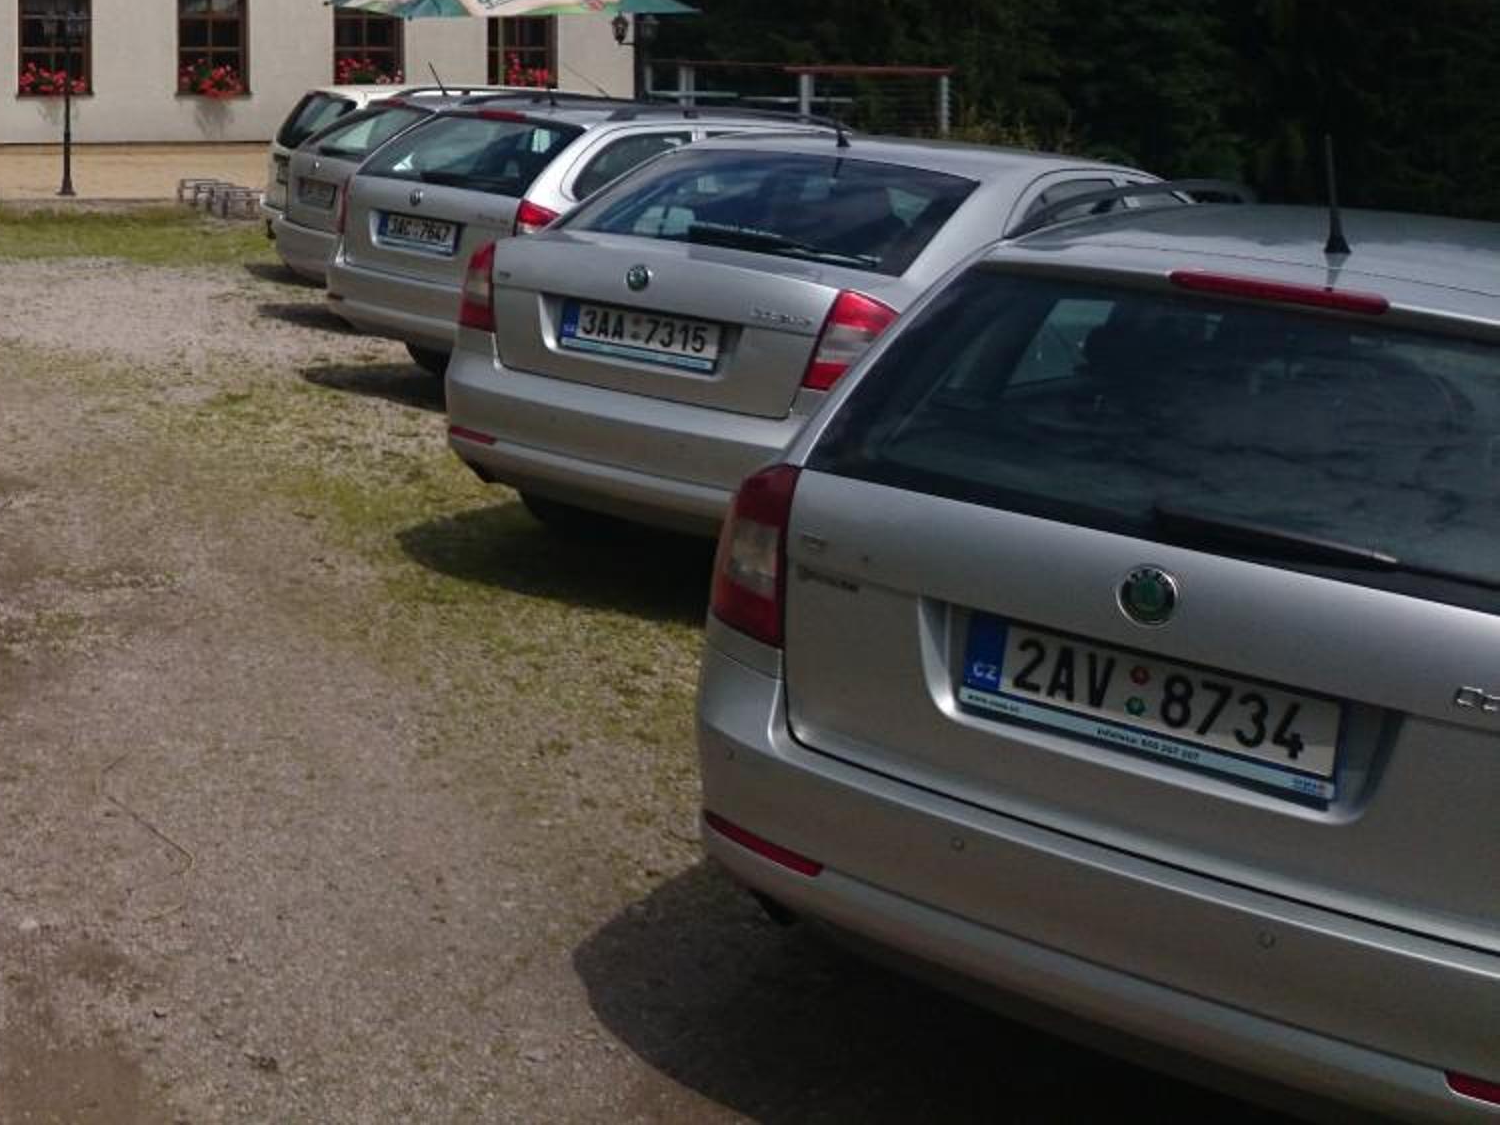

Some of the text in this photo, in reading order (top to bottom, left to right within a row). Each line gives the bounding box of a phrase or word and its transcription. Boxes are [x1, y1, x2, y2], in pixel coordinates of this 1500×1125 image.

[582, 310, 709, 353] 3AA 7315
[972, 661, 998, 681] CZ
[1012, 638, 1306, 759] 2AV 8734
